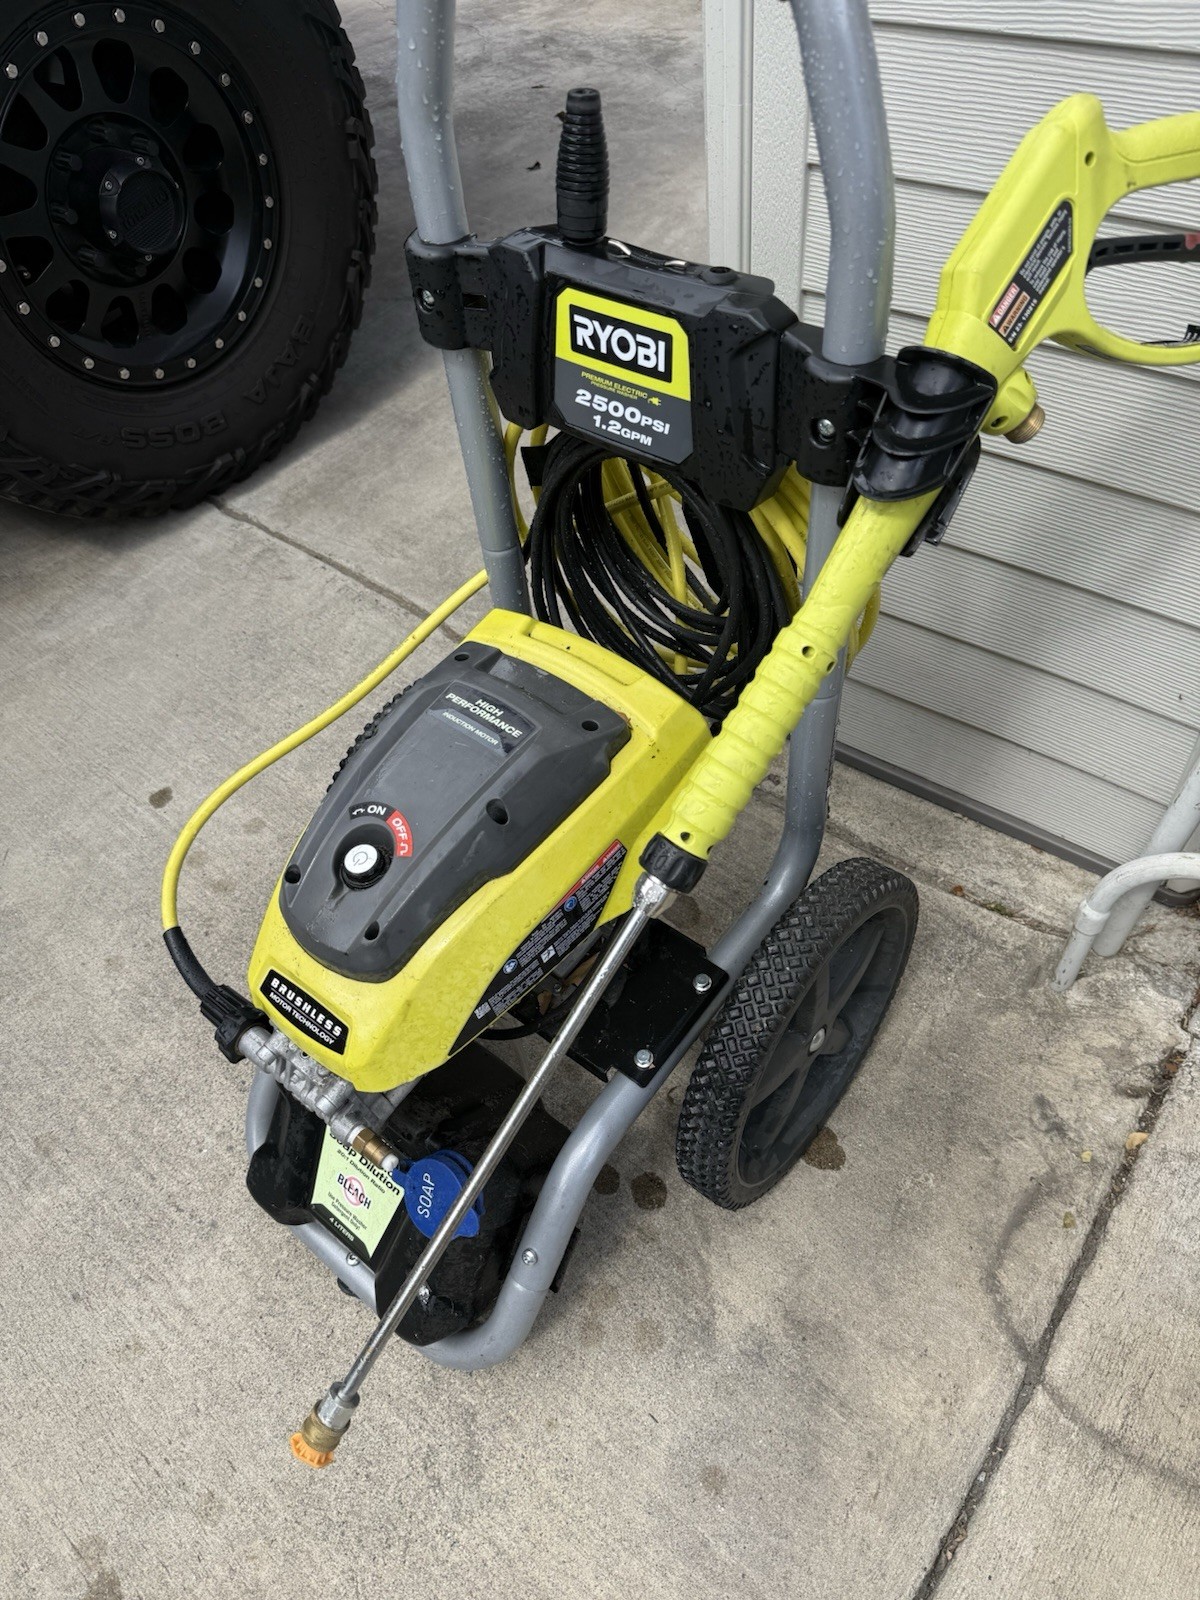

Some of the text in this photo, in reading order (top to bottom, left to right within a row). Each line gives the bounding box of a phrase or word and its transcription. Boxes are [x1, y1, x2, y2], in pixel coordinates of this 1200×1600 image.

[999, 286, 1018, 316] DANGER
[1007, 296, 1029, 326] WARNING
[573, 313, 666, 373] RYOBI
[581, 370, 648, 400] PREMIUM ELECTRIC
[120, 410, 229, 449] BOSS
[574, 388, 671, 435] 2500PSI
[593, 414, 653, 447] 1.2GPM
[445, 692, 524, 738] PERFORMANCE
[475, 699, 504, 717] HIGH
[442, 711, 499, 746] INDUCTION MOTOR
[367, 804, 387, 816] ON
[391, 817, 408, 841] OFF
[269, 991, 335, 1045] MOTOR TECHNOLOGY
[270, 977, 343, 1037] BRUSHLESS
[336, 1149, 350, 1162] 20:1
[349, 1159, 370, 1180] Dilution
[370, 1176, 386, 1194] Ratio
[358, 1153, 401, 1196] Dilution
[336, 1173, 372, 1210] BLEACH
[417, 1172, 436, 1219] SOAP
[333, 1220, 355, 1243] LITERS
